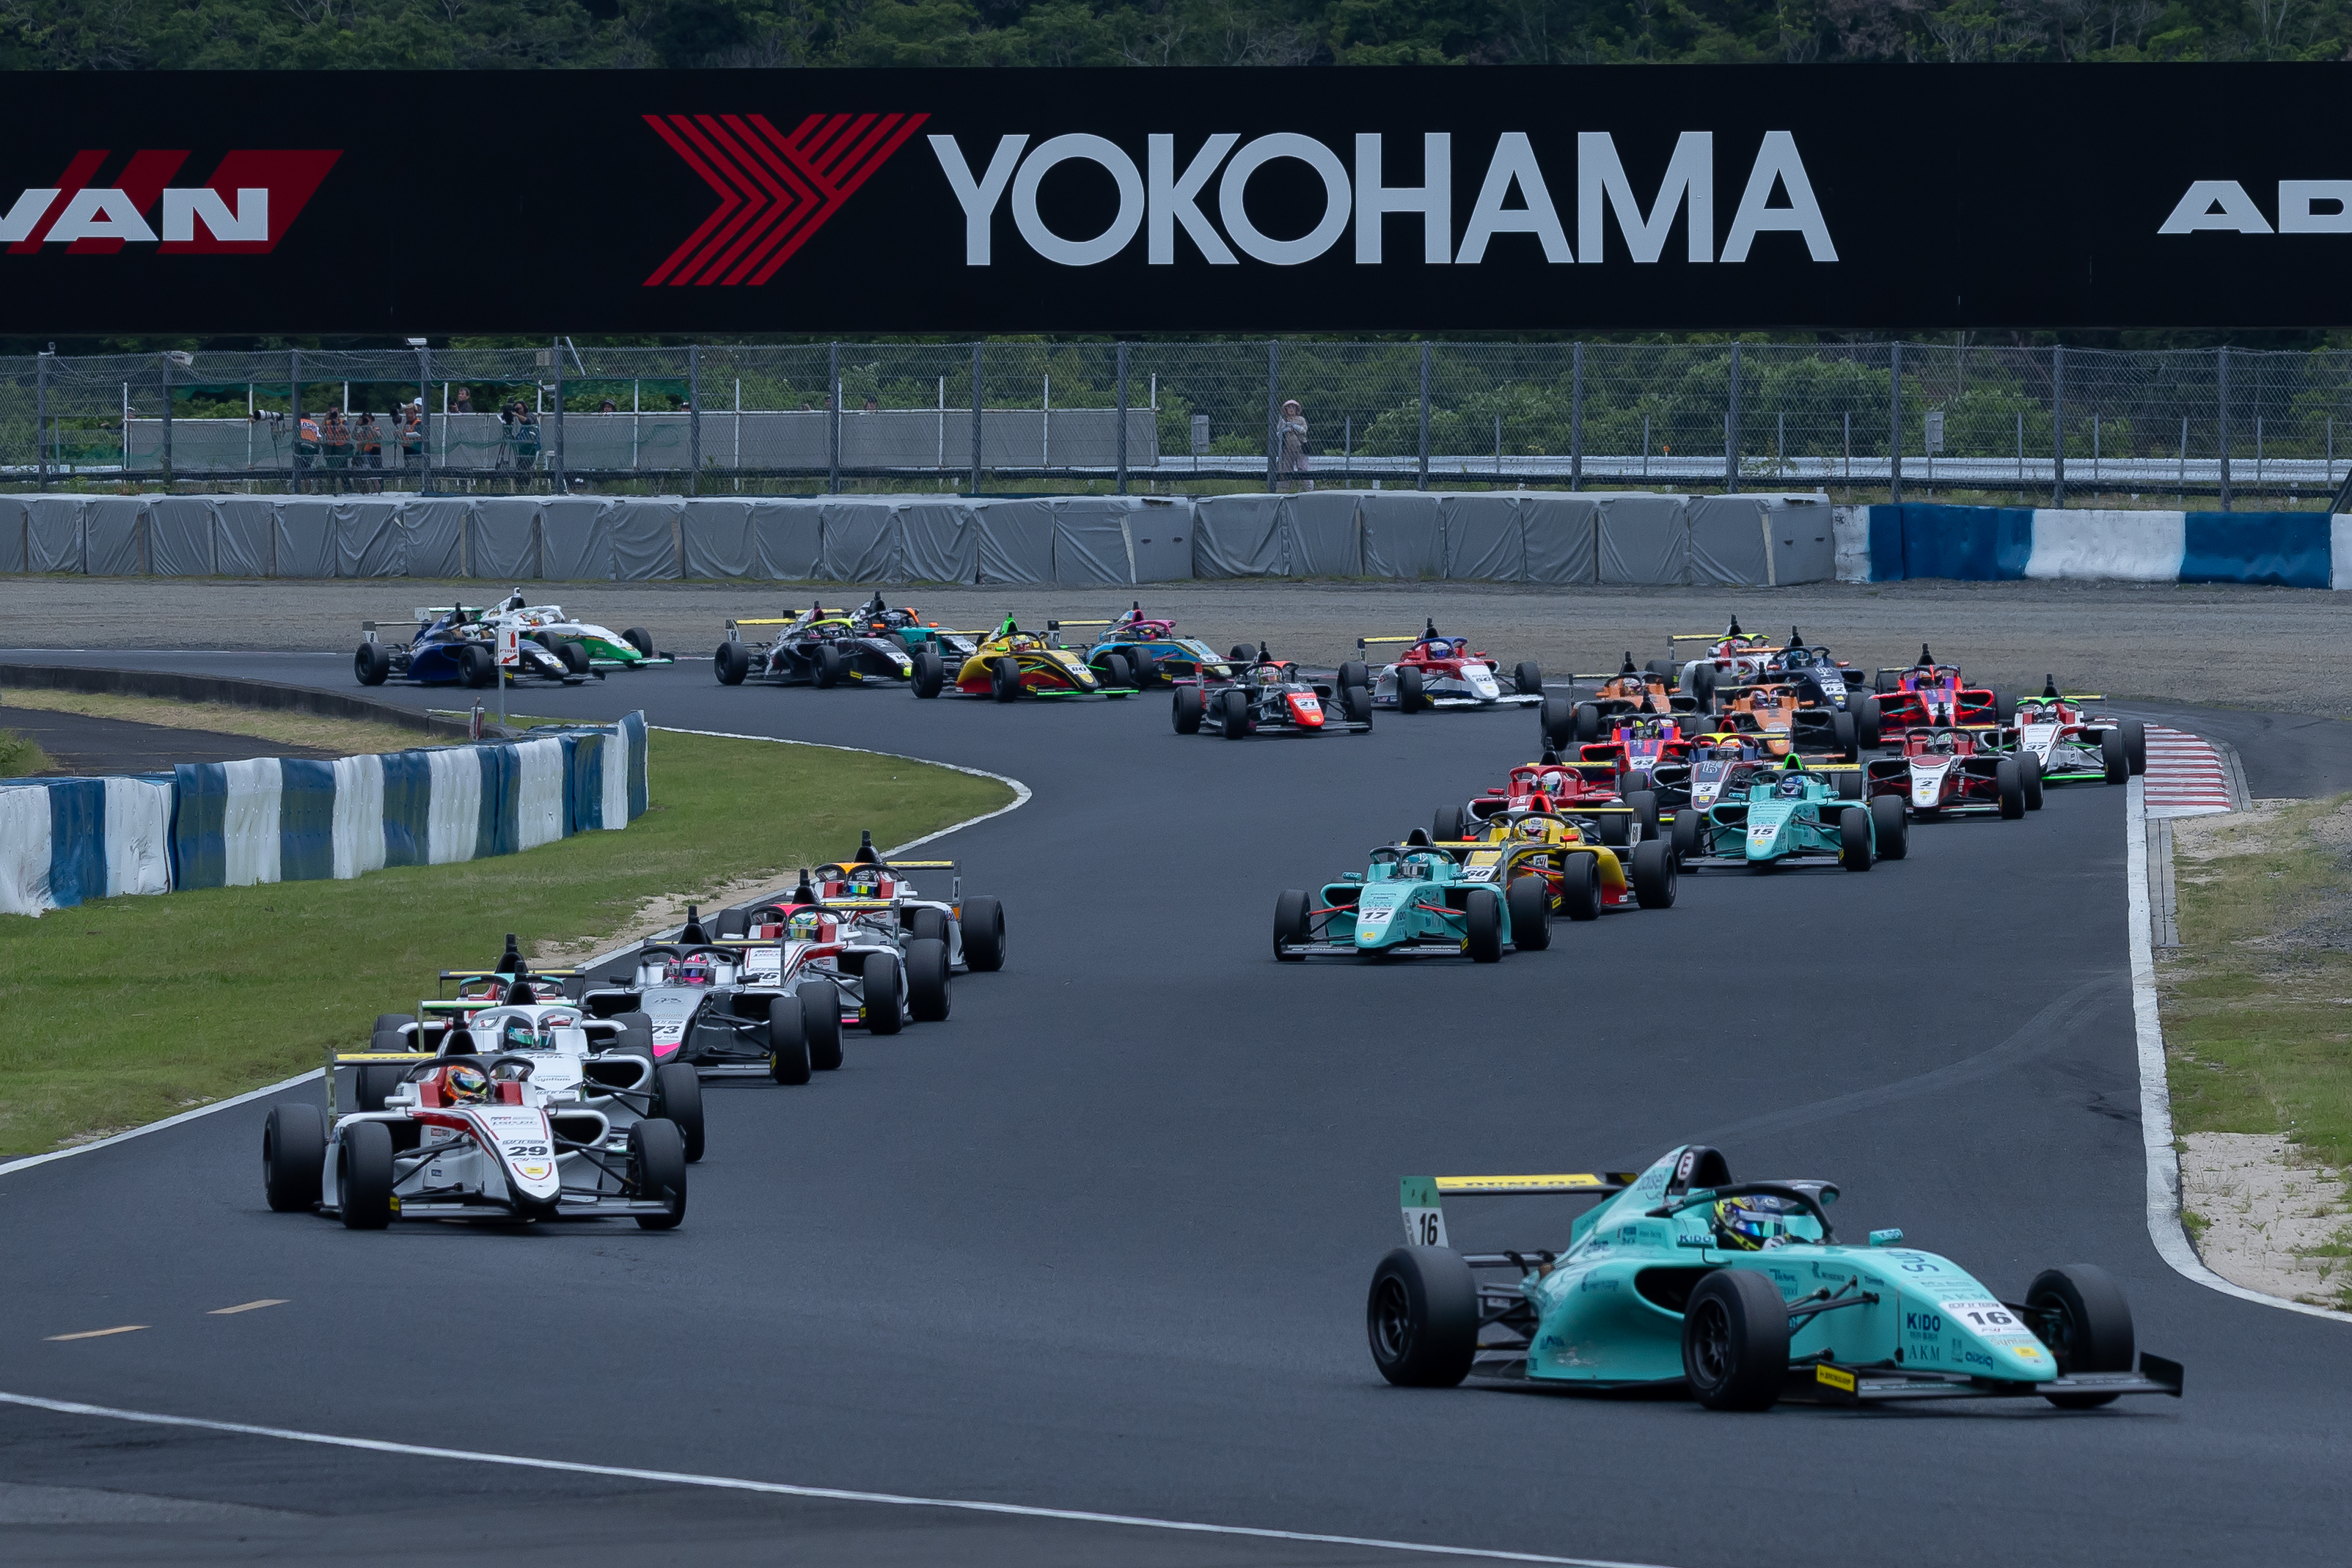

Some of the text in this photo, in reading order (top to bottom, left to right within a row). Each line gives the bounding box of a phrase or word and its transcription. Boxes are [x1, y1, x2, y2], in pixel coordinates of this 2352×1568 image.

[927, 129, 1839, 268] YOKOHAMA
[2157, 180, 2352, 233] AD
[370, 632, 375, 643] 8
[1752, 828, 1774, 837] 15
[1364, 912, 1388, 920] 17
[652, 1025, 681, 1034] 73
[507, 1146, 549, 1157] 29
[1419, 1212, 1439, 1247] 16
[1678, 1234, 1712, 1244] KIDO
[1907, 1311, 1941, 1333] KIDO
[1967, 1311, 2013, 1326] 16
[1908, 1344, 1941, 1362] AKM
